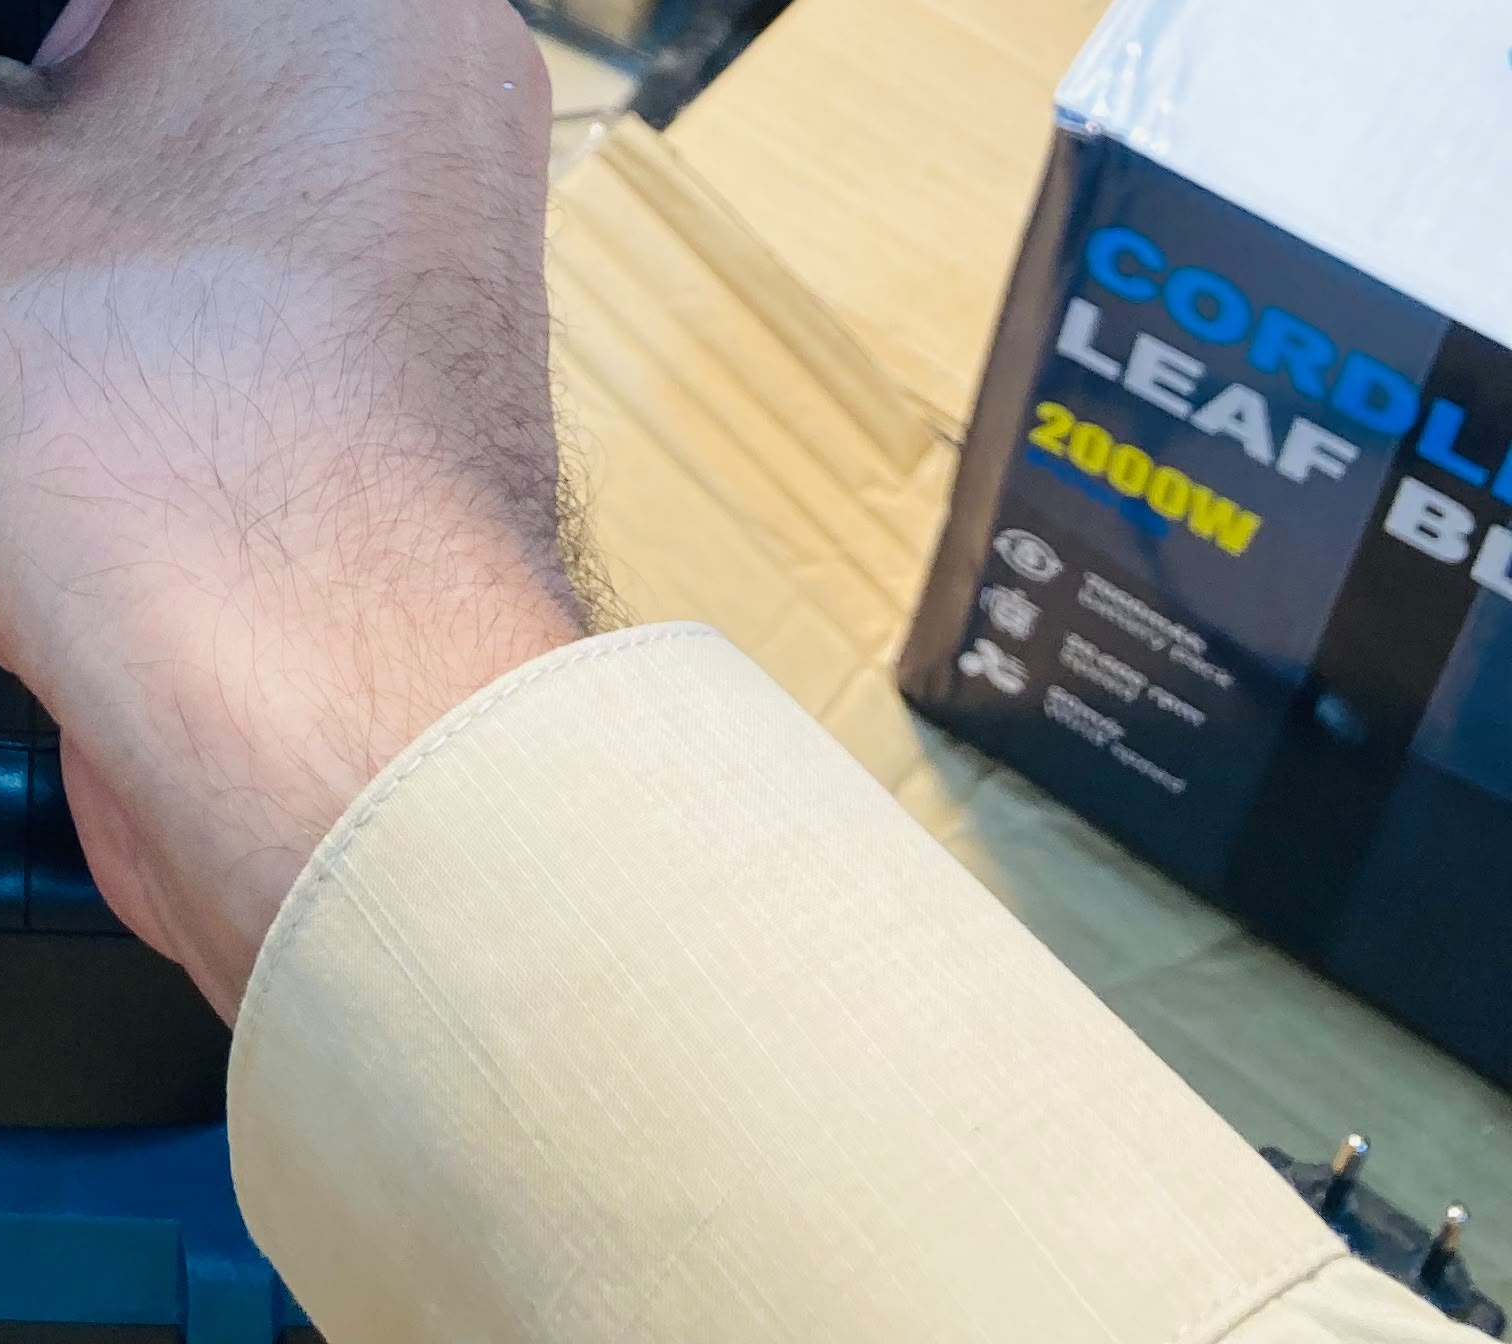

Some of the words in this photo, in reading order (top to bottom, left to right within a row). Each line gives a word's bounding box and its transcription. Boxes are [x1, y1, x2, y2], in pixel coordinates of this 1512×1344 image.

[1056, 295, 1363, 485] LEAF
[1085, 225, 1512, 505] CORDL
[1029, 400, 1265, 558] 2000W
